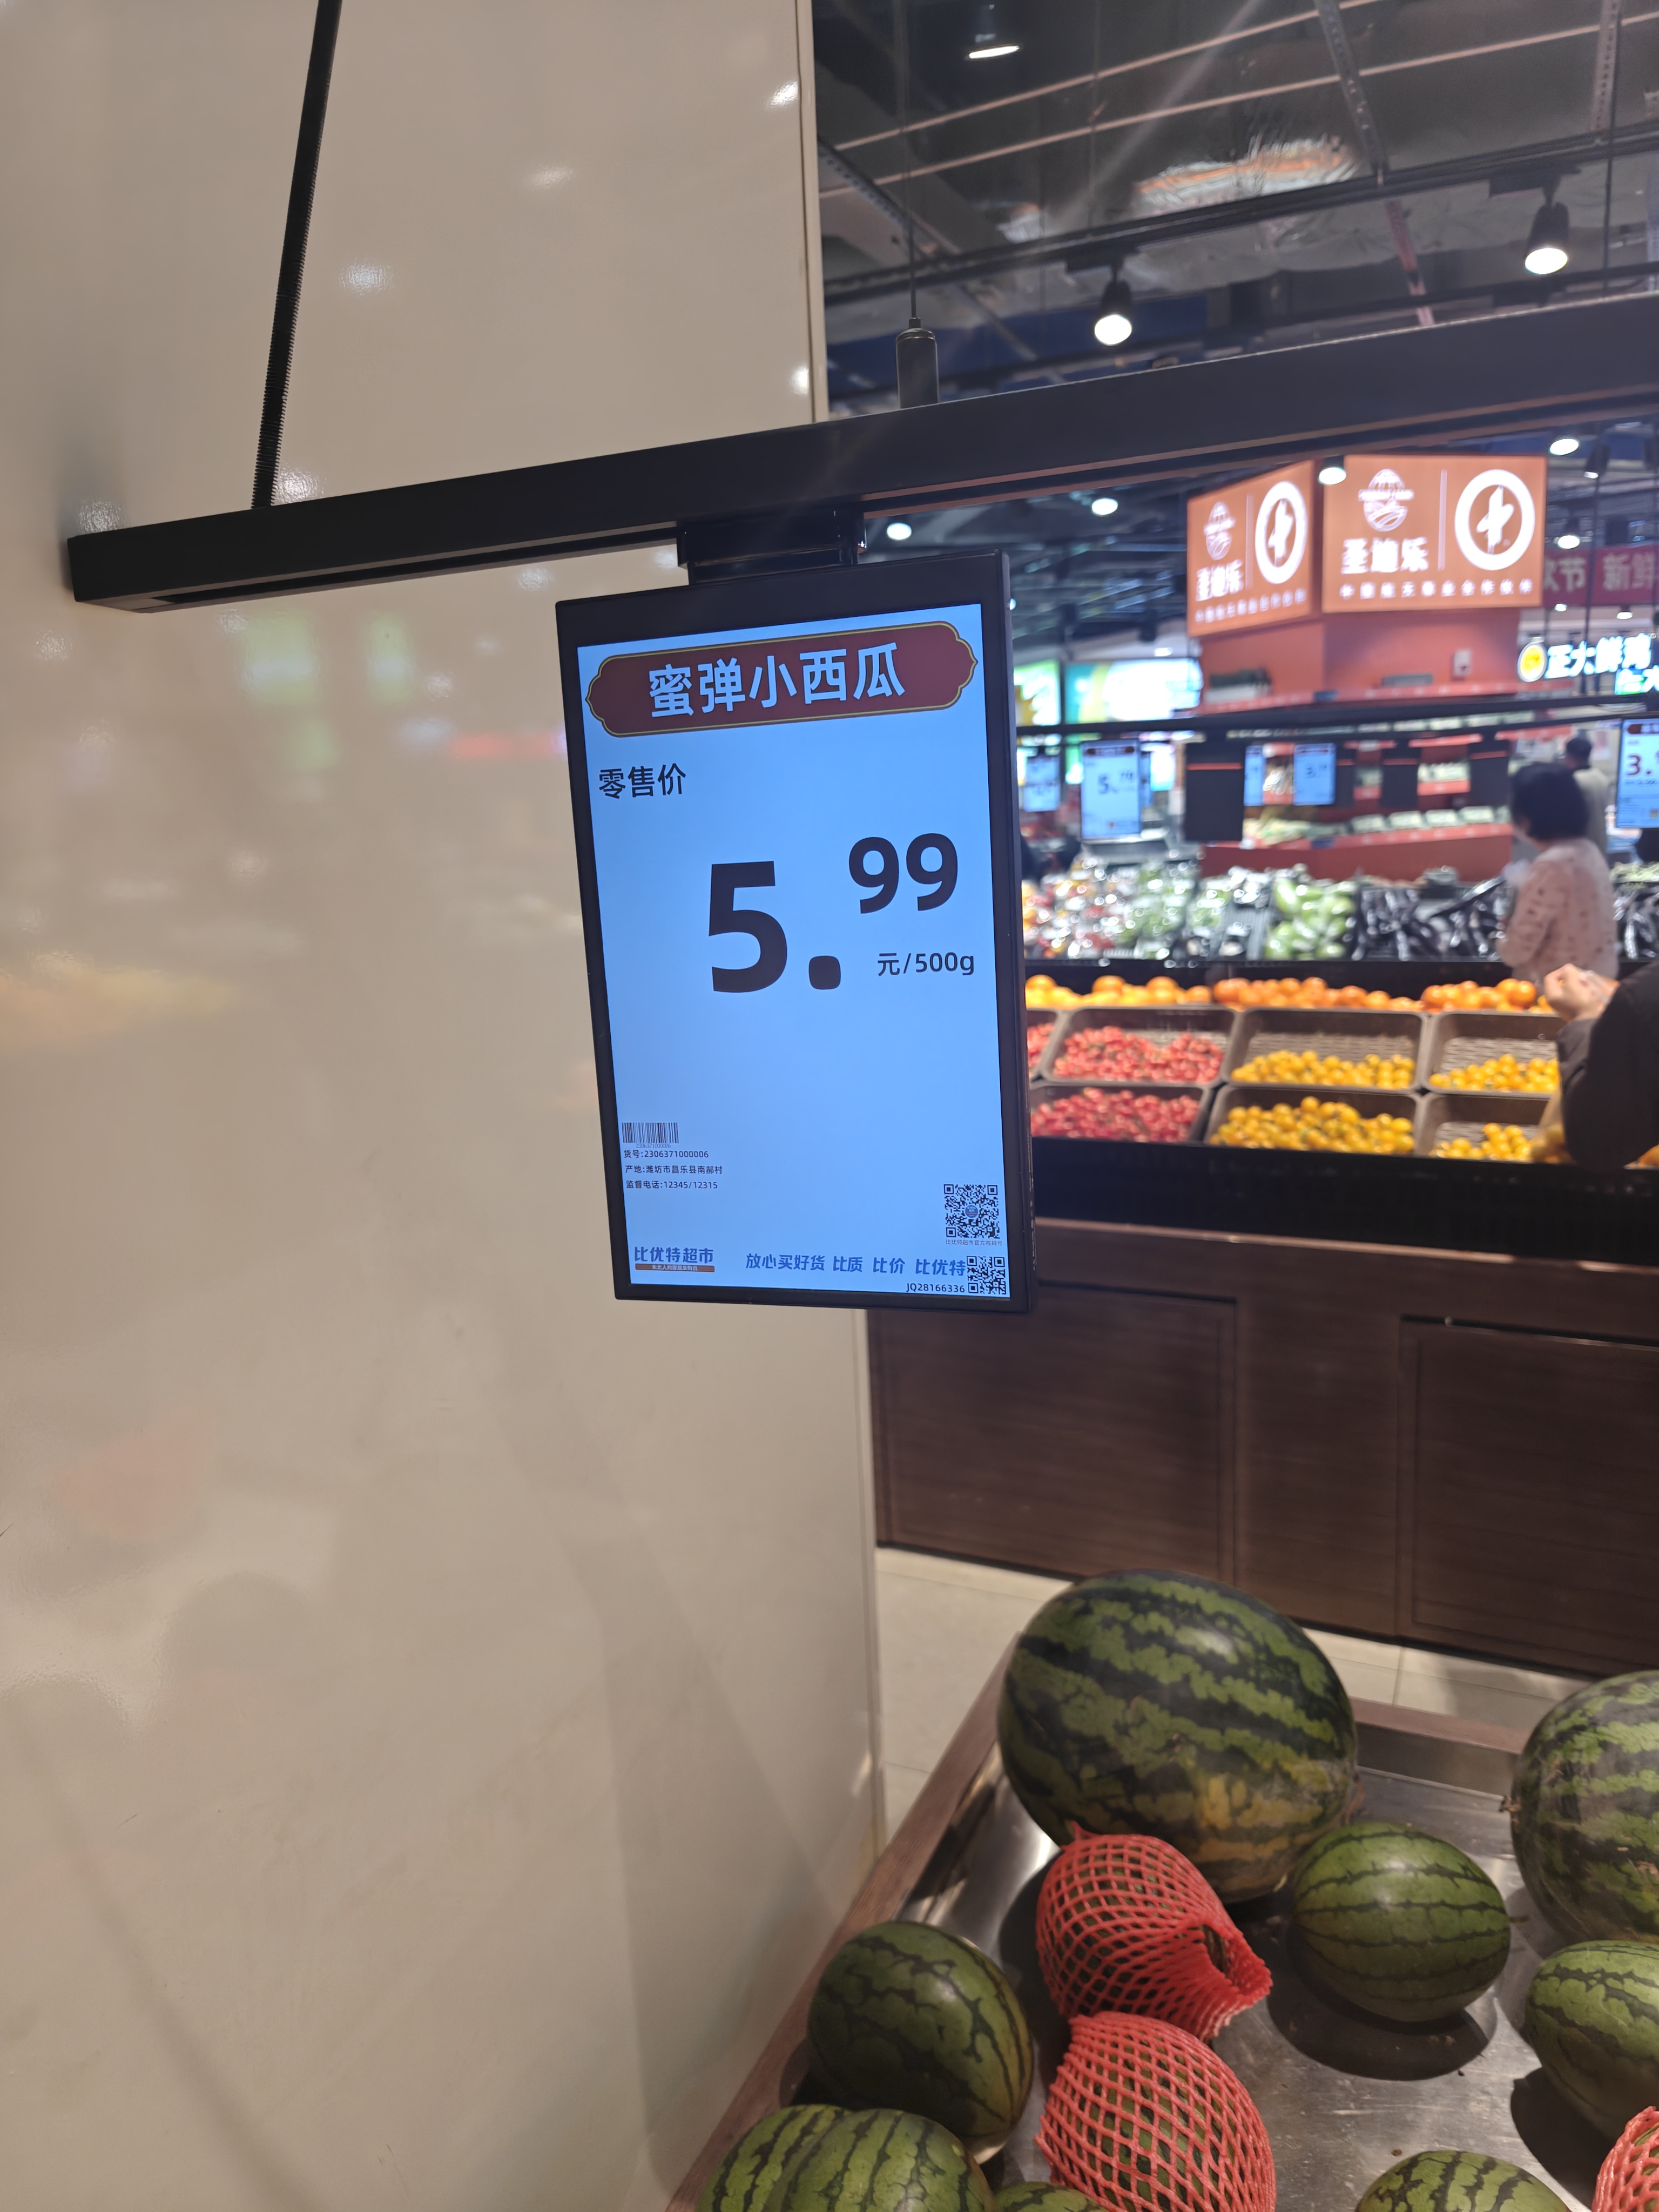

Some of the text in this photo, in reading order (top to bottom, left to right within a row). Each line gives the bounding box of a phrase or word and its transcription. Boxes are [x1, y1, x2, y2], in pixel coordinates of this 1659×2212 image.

[648, 642, 906, 718] 蜜弹小西瓜
[598, 763, 686, 799] 零售价
[877, 952, 974, 977] 元/500g
[626, 1180, 718, 1189] 监督电话:12345/12315
[634, 1246, 714, 1264] 比优特超市
[745, 1253, 966, 1276] 放心买好货 比质 比价 比优特
[906, 1283, 965, 1293] JQ28166336
